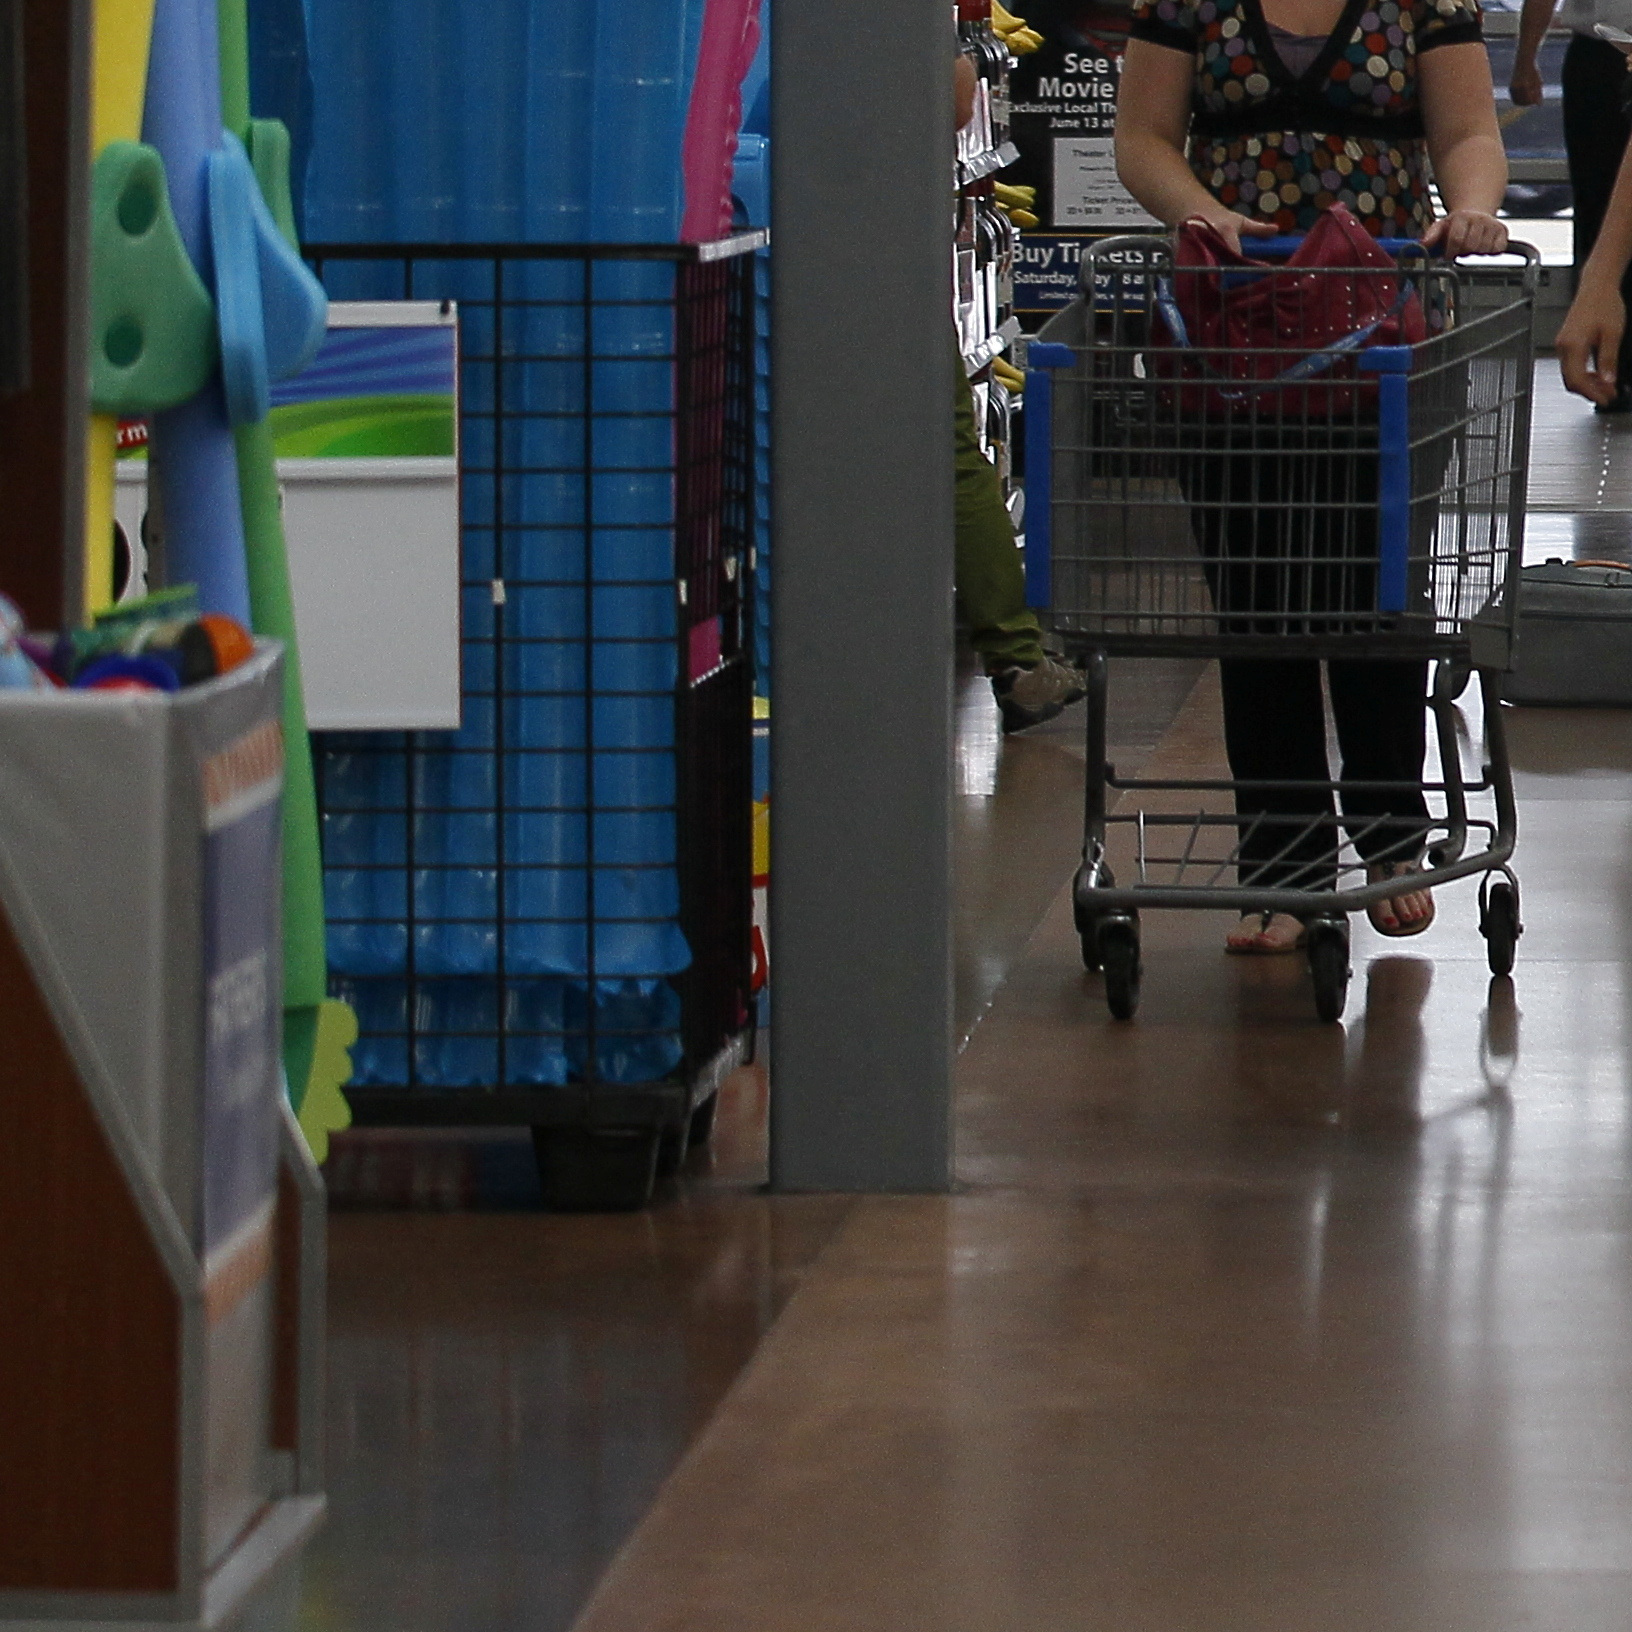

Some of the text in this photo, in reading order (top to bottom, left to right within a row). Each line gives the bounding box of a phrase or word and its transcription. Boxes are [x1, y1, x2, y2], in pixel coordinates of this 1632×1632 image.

[1063, 52, 1110, 74] See
[1038, 76, 1115, 98] Movie
[1063, 101, 1098, 114] Local
[1049, 117, 1116, 128] June 13 at
[1011, 242, 1054, 269] Buy
[1057, 242, 1144, 264] Tiets
[1013, 270, 1078, 287] Saturday,
